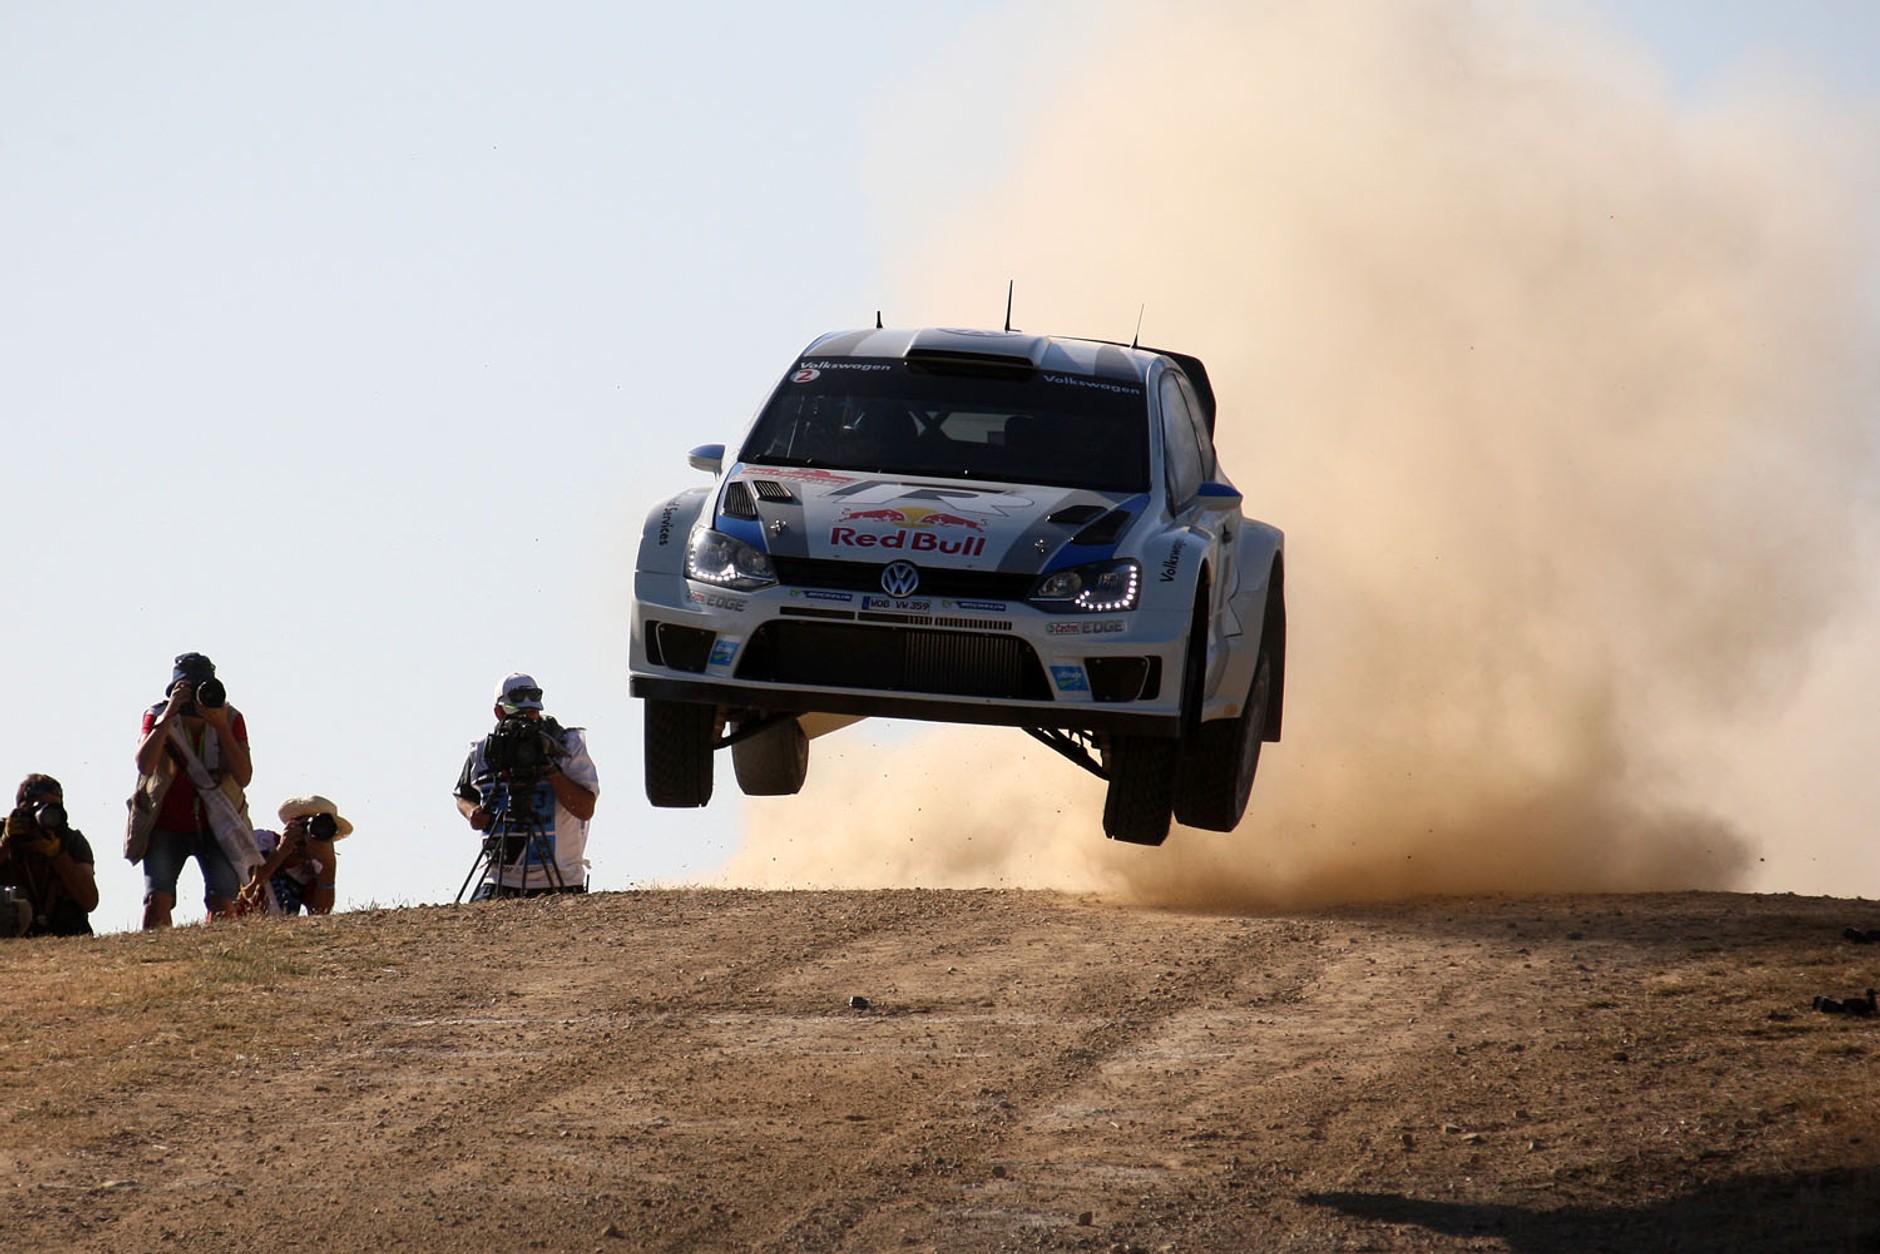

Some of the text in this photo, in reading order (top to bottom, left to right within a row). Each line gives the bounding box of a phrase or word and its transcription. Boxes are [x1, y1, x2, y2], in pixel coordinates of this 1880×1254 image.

[800, 361, 891, 371] Volkswagen
[796, 370, 813, 382] 2
[1043, 374, 1140, 395] Volkswagen
[658, 507, 679, 546] Services
[830, 527, 986, 557] Red Bull
[707, 594, 748, 613] EDGE
[869, 599, 930, 611] WOB VW 359
[1082, 620, 1124, 635] EDGE
